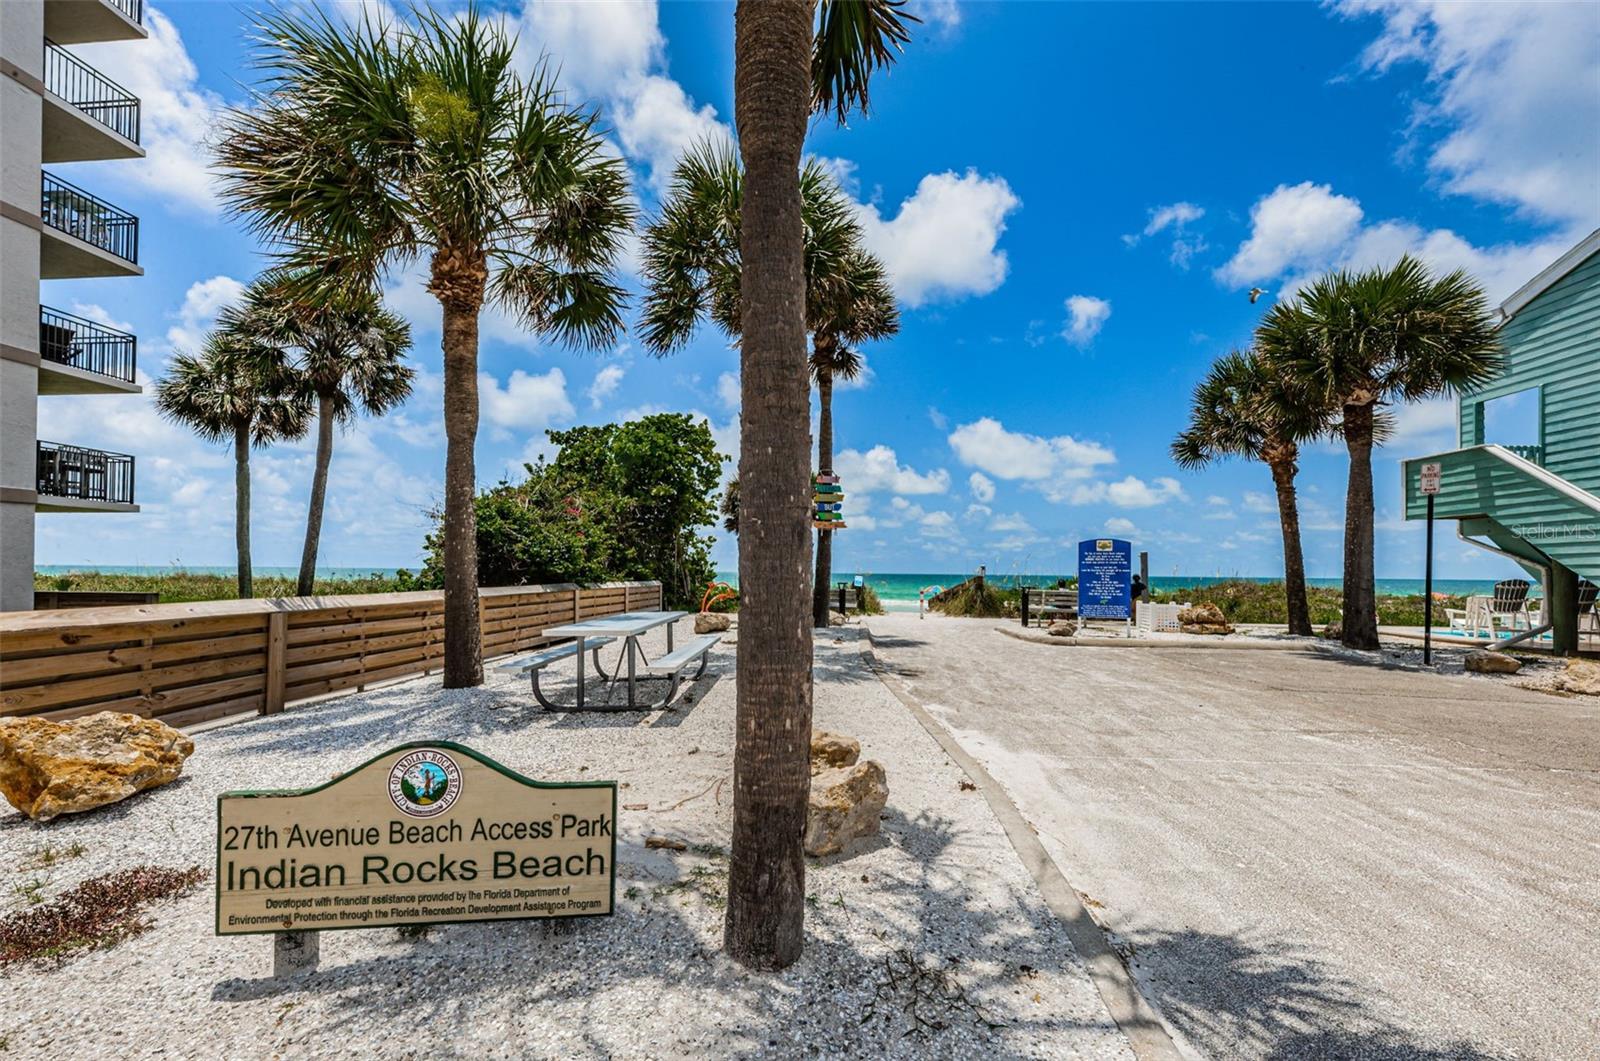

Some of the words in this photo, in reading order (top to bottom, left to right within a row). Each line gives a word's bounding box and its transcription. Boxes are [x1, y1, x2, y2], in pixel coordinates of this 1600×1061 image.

[397, 752, 427, 773] INDIAN
[431, 753, 456, 776] ROCKS
[391, 773, 401, 785] OF
[442, 778, 458, 805] BEACH
[391, 788, 408, 807] CITY
[224, 824, 278, 851] 27th
[287, 823, 380, 849] Avenue
[389, 818, 462, 845] Beach
[470, 817, 553, 841] Access
[560, 813, 611, 838] Park
[227, 858, 345, 891] Indian
[362, 853, 478, 885] Rocks
[493, 847, 605, 880] Beach
[265, 897, 313, 910] Developed
[315, 896, 333, 907] with
[333, 895, 370, 906] financial
[371, 893, 415, 905] assistance
[417, 890, 455, 904] provided
[456, 889, 467, 903] by
[468, 889, 482, 900] the
[483, 888, 512, 899] Florida
[513, 886, 560, 899] Department
[561, 885, 571, 896] of
[228, 913, 292, 926] Environmental
[293, 910, 338, 922] Protection
[339, 908, 373, 921] through
[374, 908, 389, 918] the
[390, 905, 420, 918] Florida
[422, 904, 466, 916] Recreation
[468, 901, 521, 914] Development
[523, 900, 566, 912] Assistance
[567, 898, 602, 910] Program
